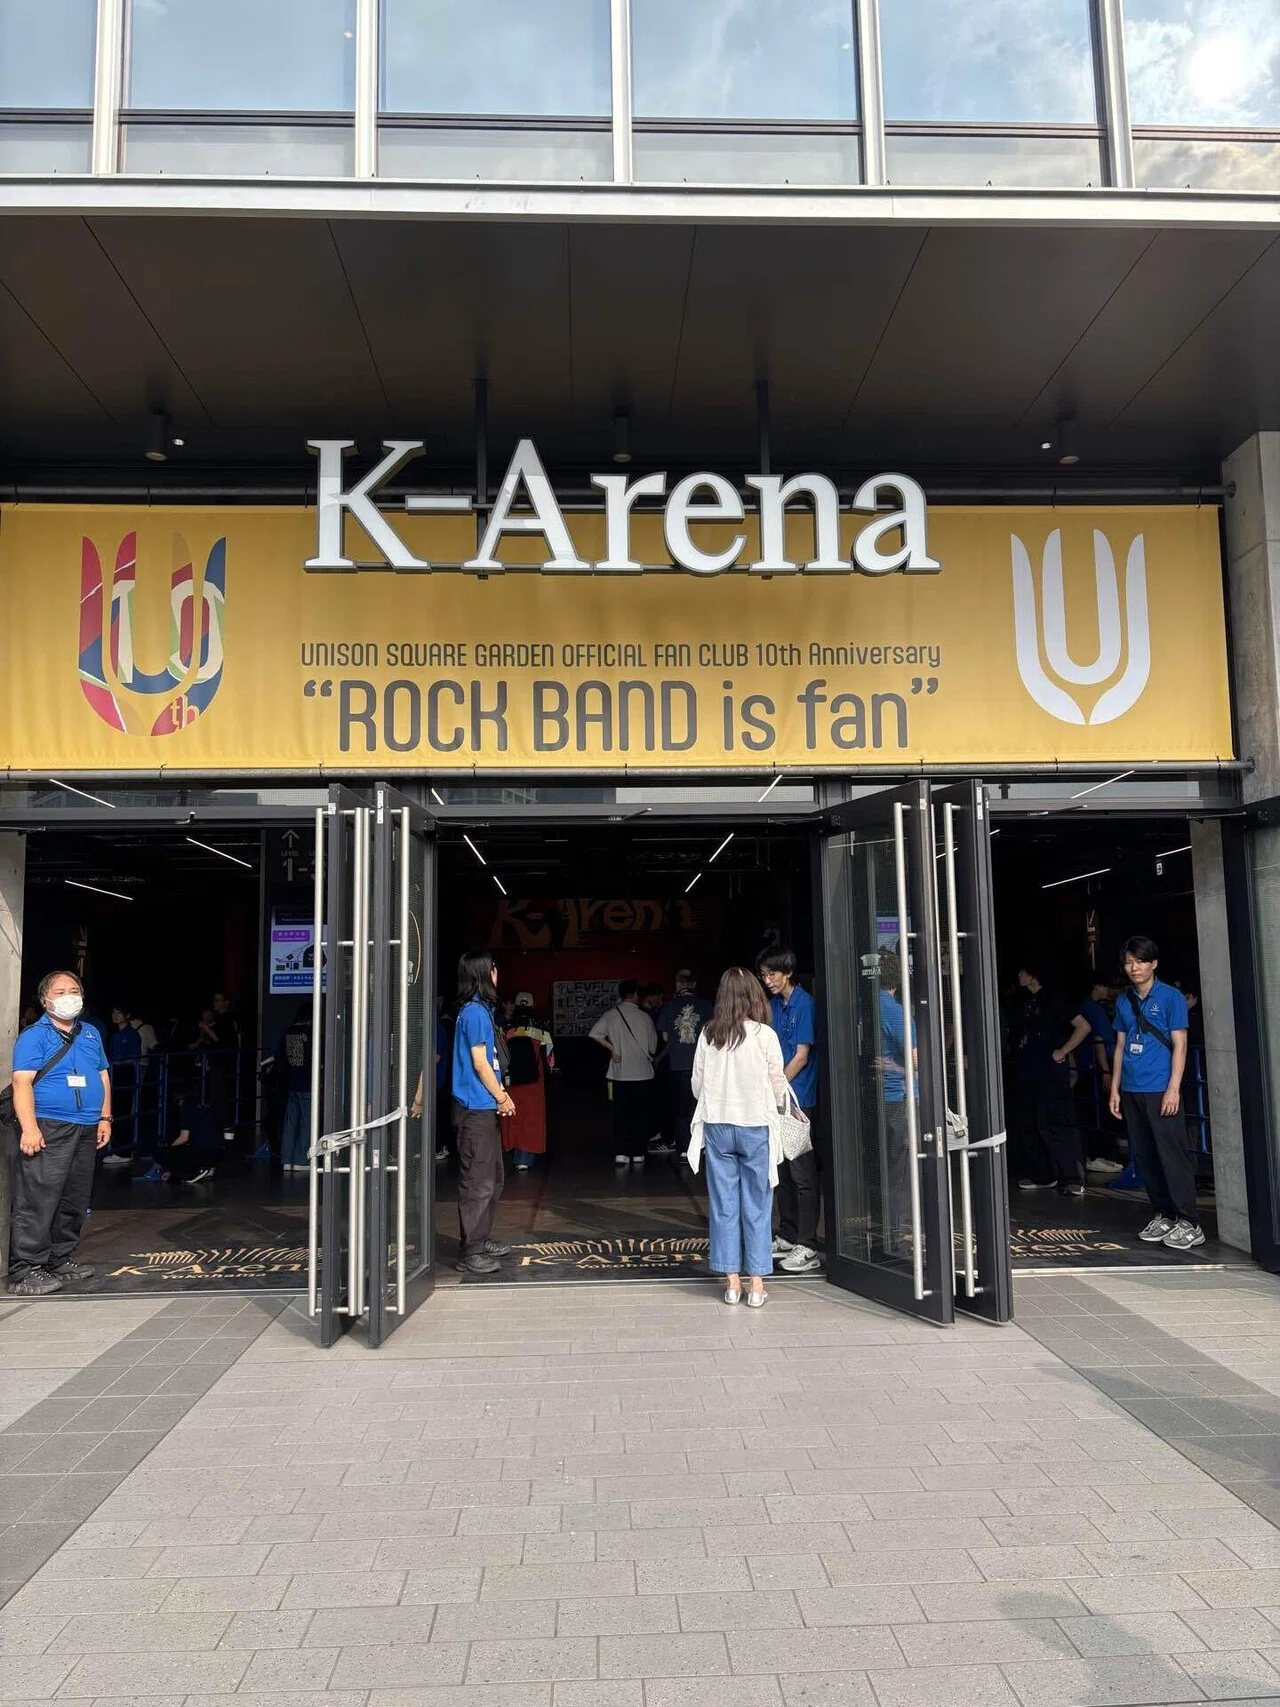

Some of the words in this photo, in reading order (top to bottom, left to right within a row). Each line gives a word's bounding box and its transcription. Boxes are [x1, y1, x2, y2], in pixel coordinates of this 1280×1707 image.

[303, 438, 942, 576] K-Arena
[301, 642, 378, 667] UNISON
[386, 642, 467, 667] SQUARE
[475, 643, 554, 667] GARDEN
[562, 643, 647, 667] OFFICIAL
[654, 643, 691, 667] FAN
[699, 643, 748, 667] CLUB
[755, 642, 802, 667] 10th
[809, 642, 941, 669] Anniversary
[532, 679, 698, 752] BAND
[722, 679, 776, 752] is
[517, 1253, 710, 1267] K-Aren
